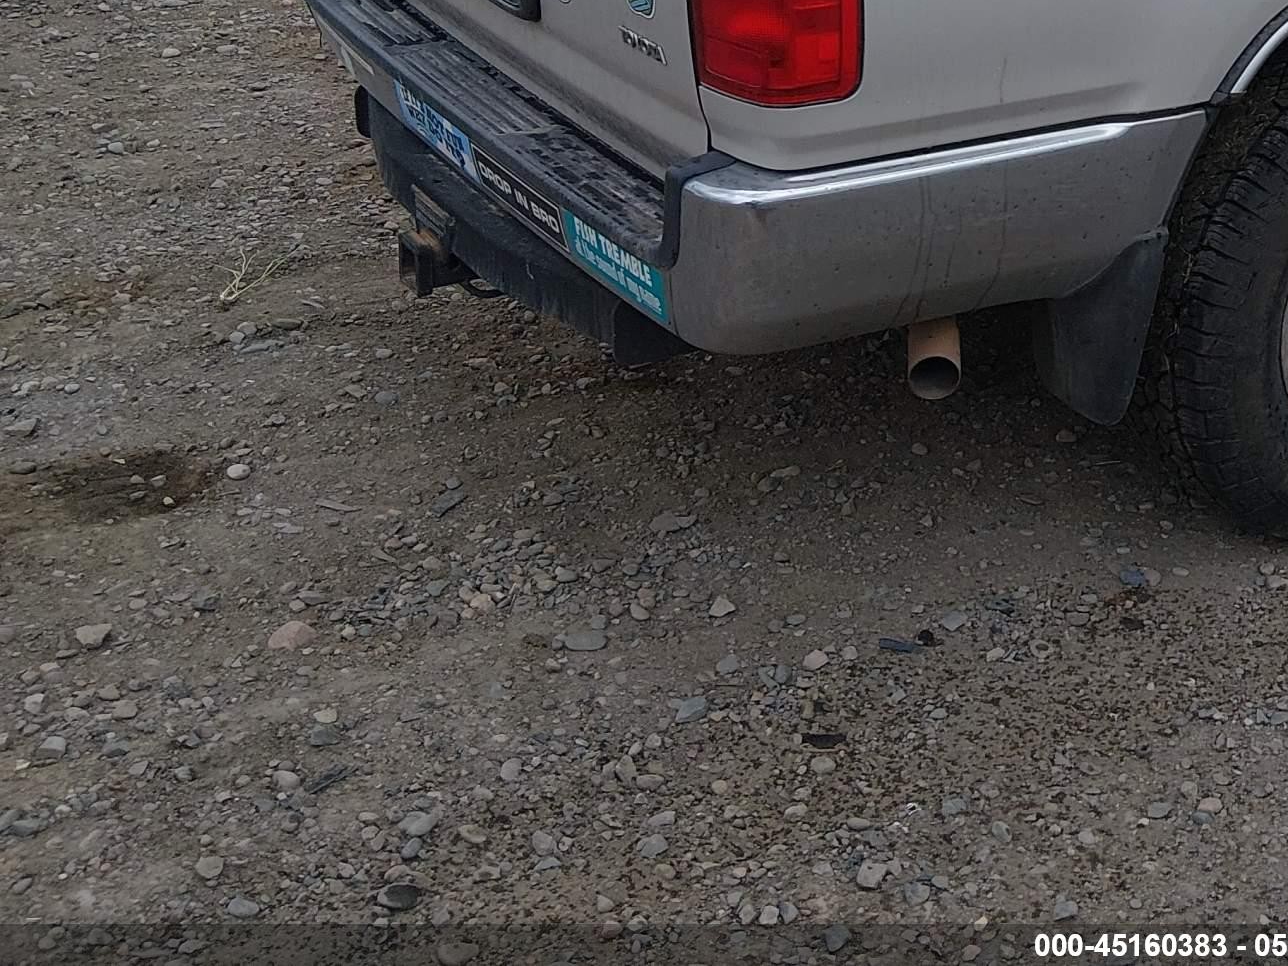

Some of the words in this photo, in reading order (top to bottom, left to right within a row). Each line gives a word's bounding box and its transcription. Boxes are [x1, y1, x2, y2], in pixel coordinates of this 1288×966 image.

[478, 160, 512, 195] DROP
[513, 187, 530, 211] IN
[529, 200, 560, 234] BRO
[573, 216, 599, 250] FISH
[598, 233, 653, 288] TREMBLE
